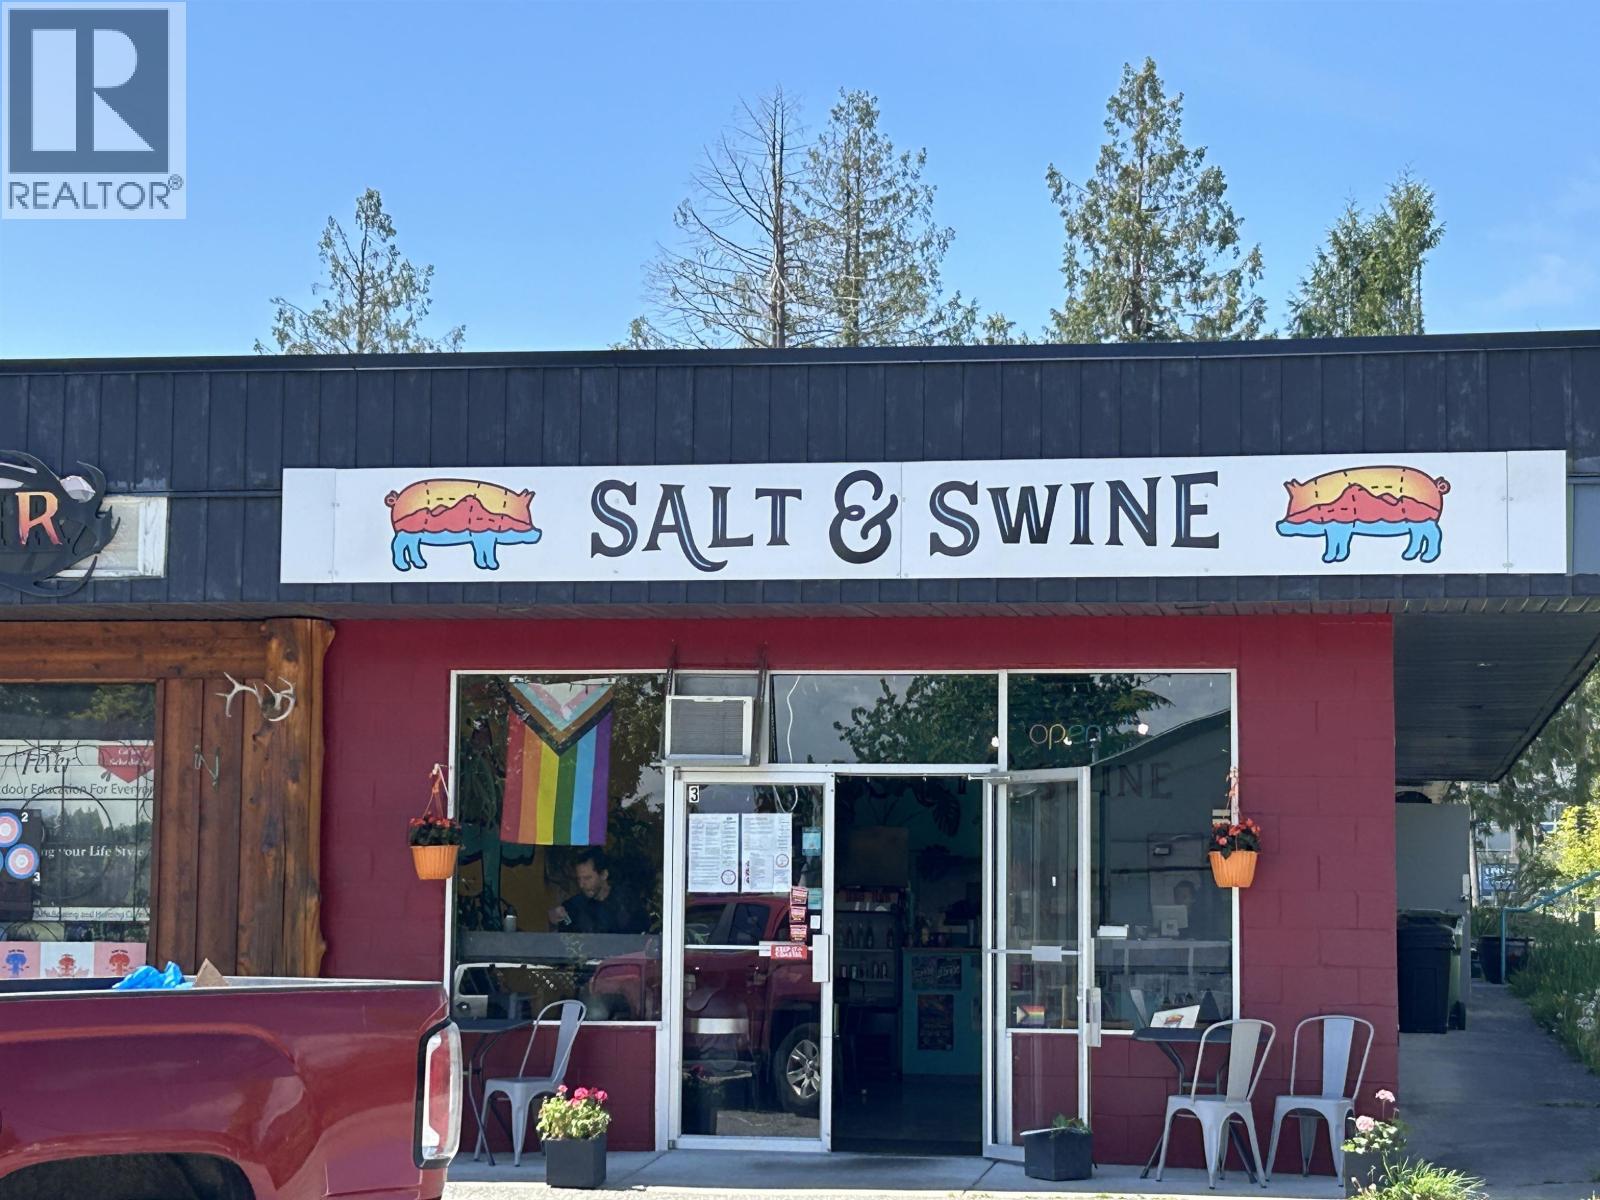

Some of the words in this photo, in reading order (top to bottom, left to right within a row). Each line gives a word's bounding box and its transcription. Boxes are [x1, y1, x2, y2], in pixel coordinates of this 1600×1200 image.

[590, 479, 802, 573] SALT
[828, 469, 899, 565] &
[929, 470, 1220, 558] SWINE
[1029, 723, 1102, 750] open
[31, 783, 87, 795] Education
[90, 783, 108, 795] For
[690, 786, 699, 802] 3
[21, 811, 29, 823] 2
[89, 844, 112, 857] Life
[115, 845, 144, 859] Stye
[33, 871, 41, 882] 3
